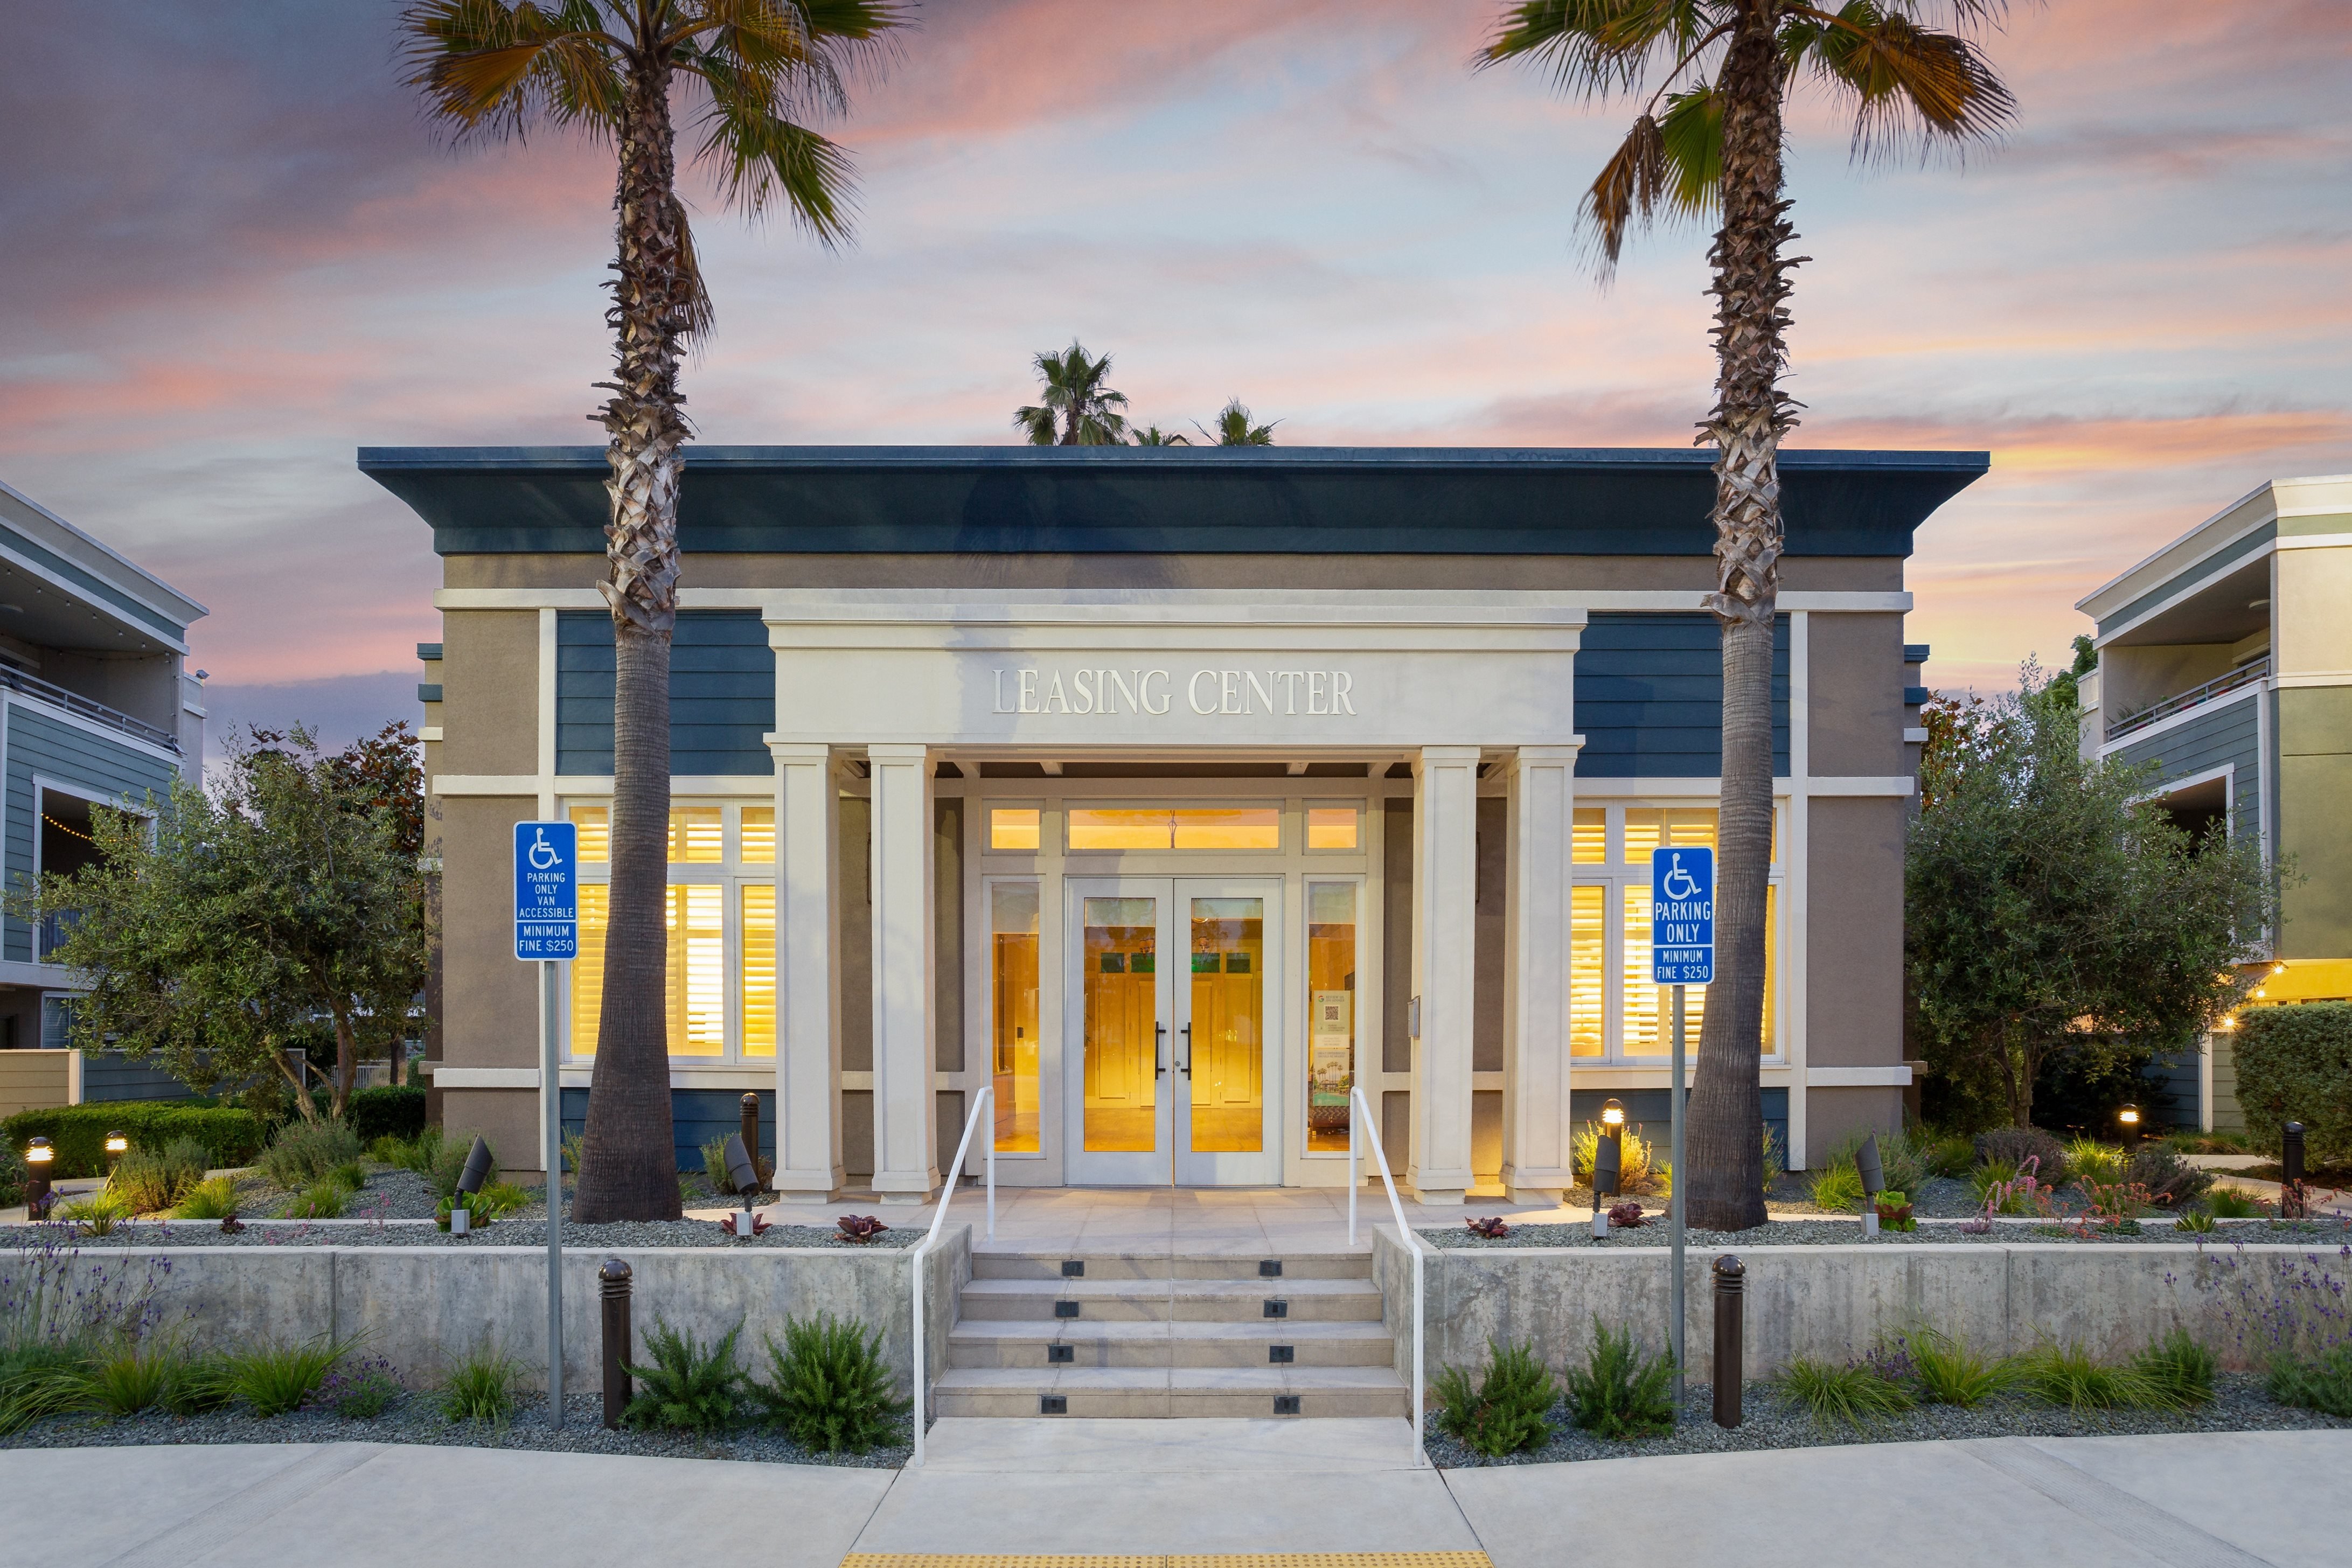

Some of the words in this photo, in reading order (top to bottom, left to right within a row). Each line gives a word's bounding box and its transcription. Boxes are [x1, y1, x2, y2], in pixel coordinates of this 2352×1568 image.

[992, 668, 1173, 715] LEASING
[1188, 669, 1357, 716] CENTER
[527, 873, 565, 882] PARKING
[535, 884, 557, 894] ONLY
[537, 896, 555, 906] VAN
[519, 908, 573, 918] ACCESSIBLE
[1655, 901, 1710, 921] PARKING
[523, 925, 569, 937] MINIMUM
[1667, 923, 1700, 943] ONLY
[519, 940, 542, 951] FINE
[546, 939, 574, 952] $250
[1663, 950, 1702, 963] MINIMUM
[1657, 966, 1676, 979] FINE
[1683, 965, 1708, 980] $250
